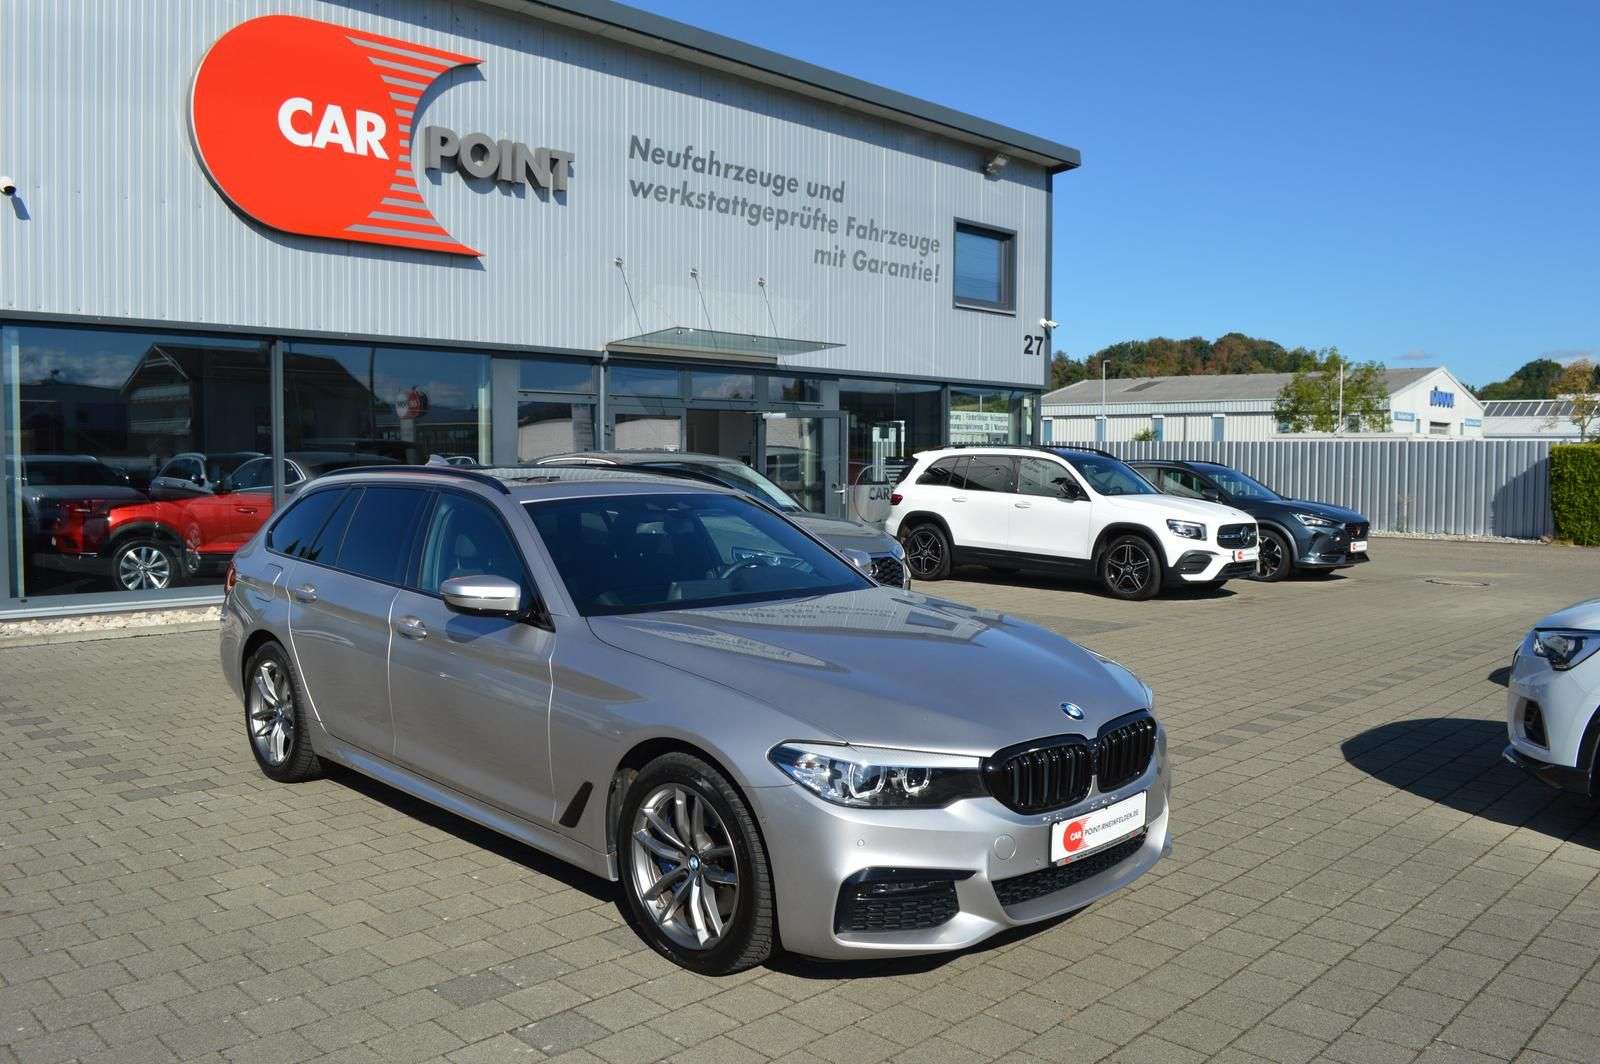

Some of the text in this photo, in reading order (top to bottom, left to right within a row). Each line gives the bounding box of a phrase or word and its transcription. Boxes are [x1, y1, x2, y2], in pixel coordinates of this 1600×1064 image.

[278, 97, 390, 160] CAR
[425, 125, 574, 192] POINT
[629, 134, 845, 203] Neufahrzeuge und
[629, 179, 941, 256] werkstattgeprüfte Fahrzeuge
[813, 244, 940, 283] mit Garantie!
[1023, 334, 1044, 356] 27
[1070, 832, 1083, 842] CAR
